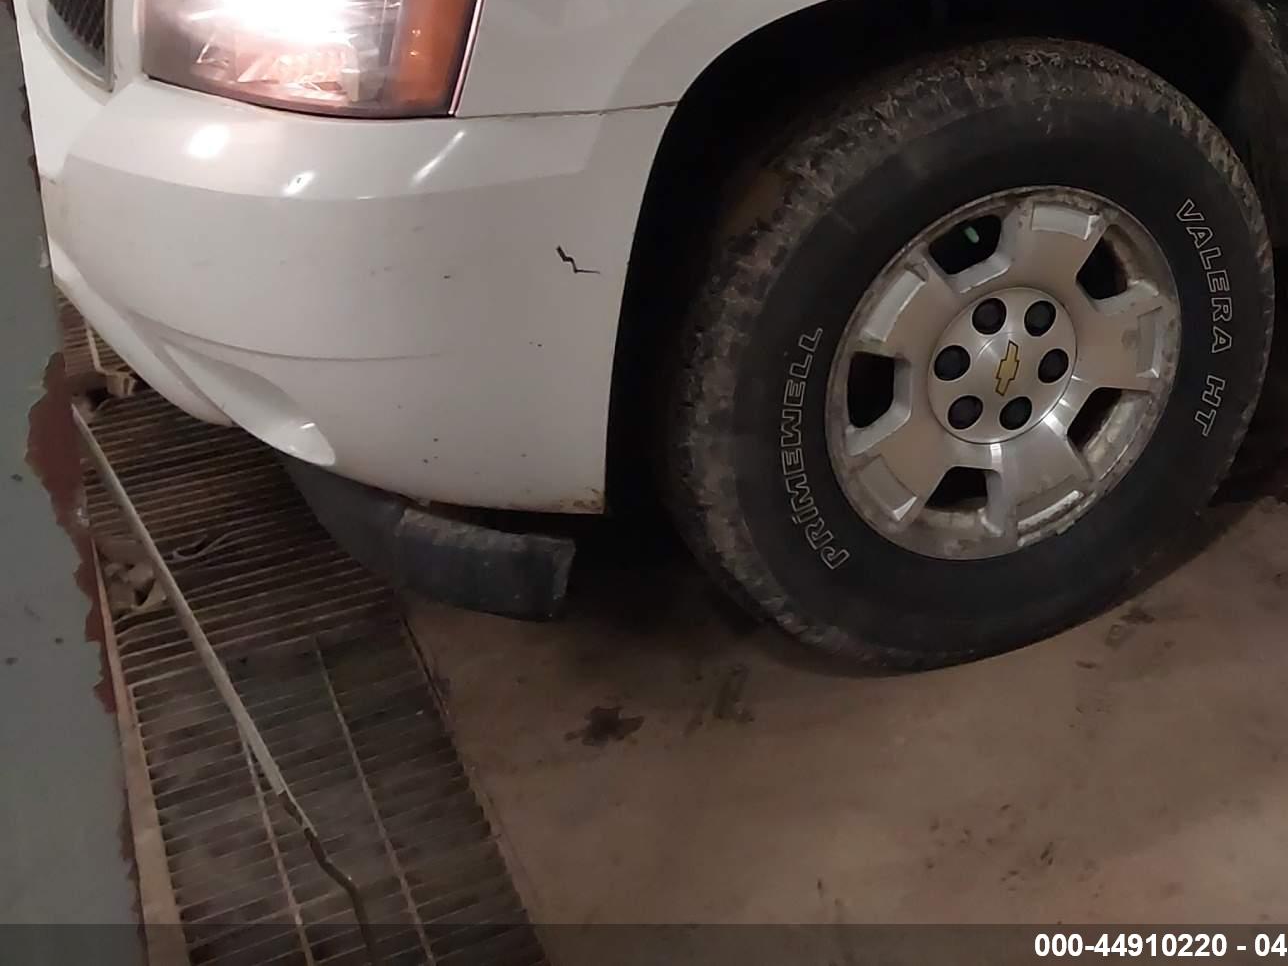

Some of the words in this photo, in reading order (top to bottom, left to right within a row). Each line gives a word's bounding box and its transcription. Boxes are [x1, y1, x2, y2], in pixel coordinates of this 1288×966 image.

[1176, 198, 1233, 354] VALERA
[780, 327, 850, 570] PRIMEWELL
[1194, 374, 1226, 437] HT
